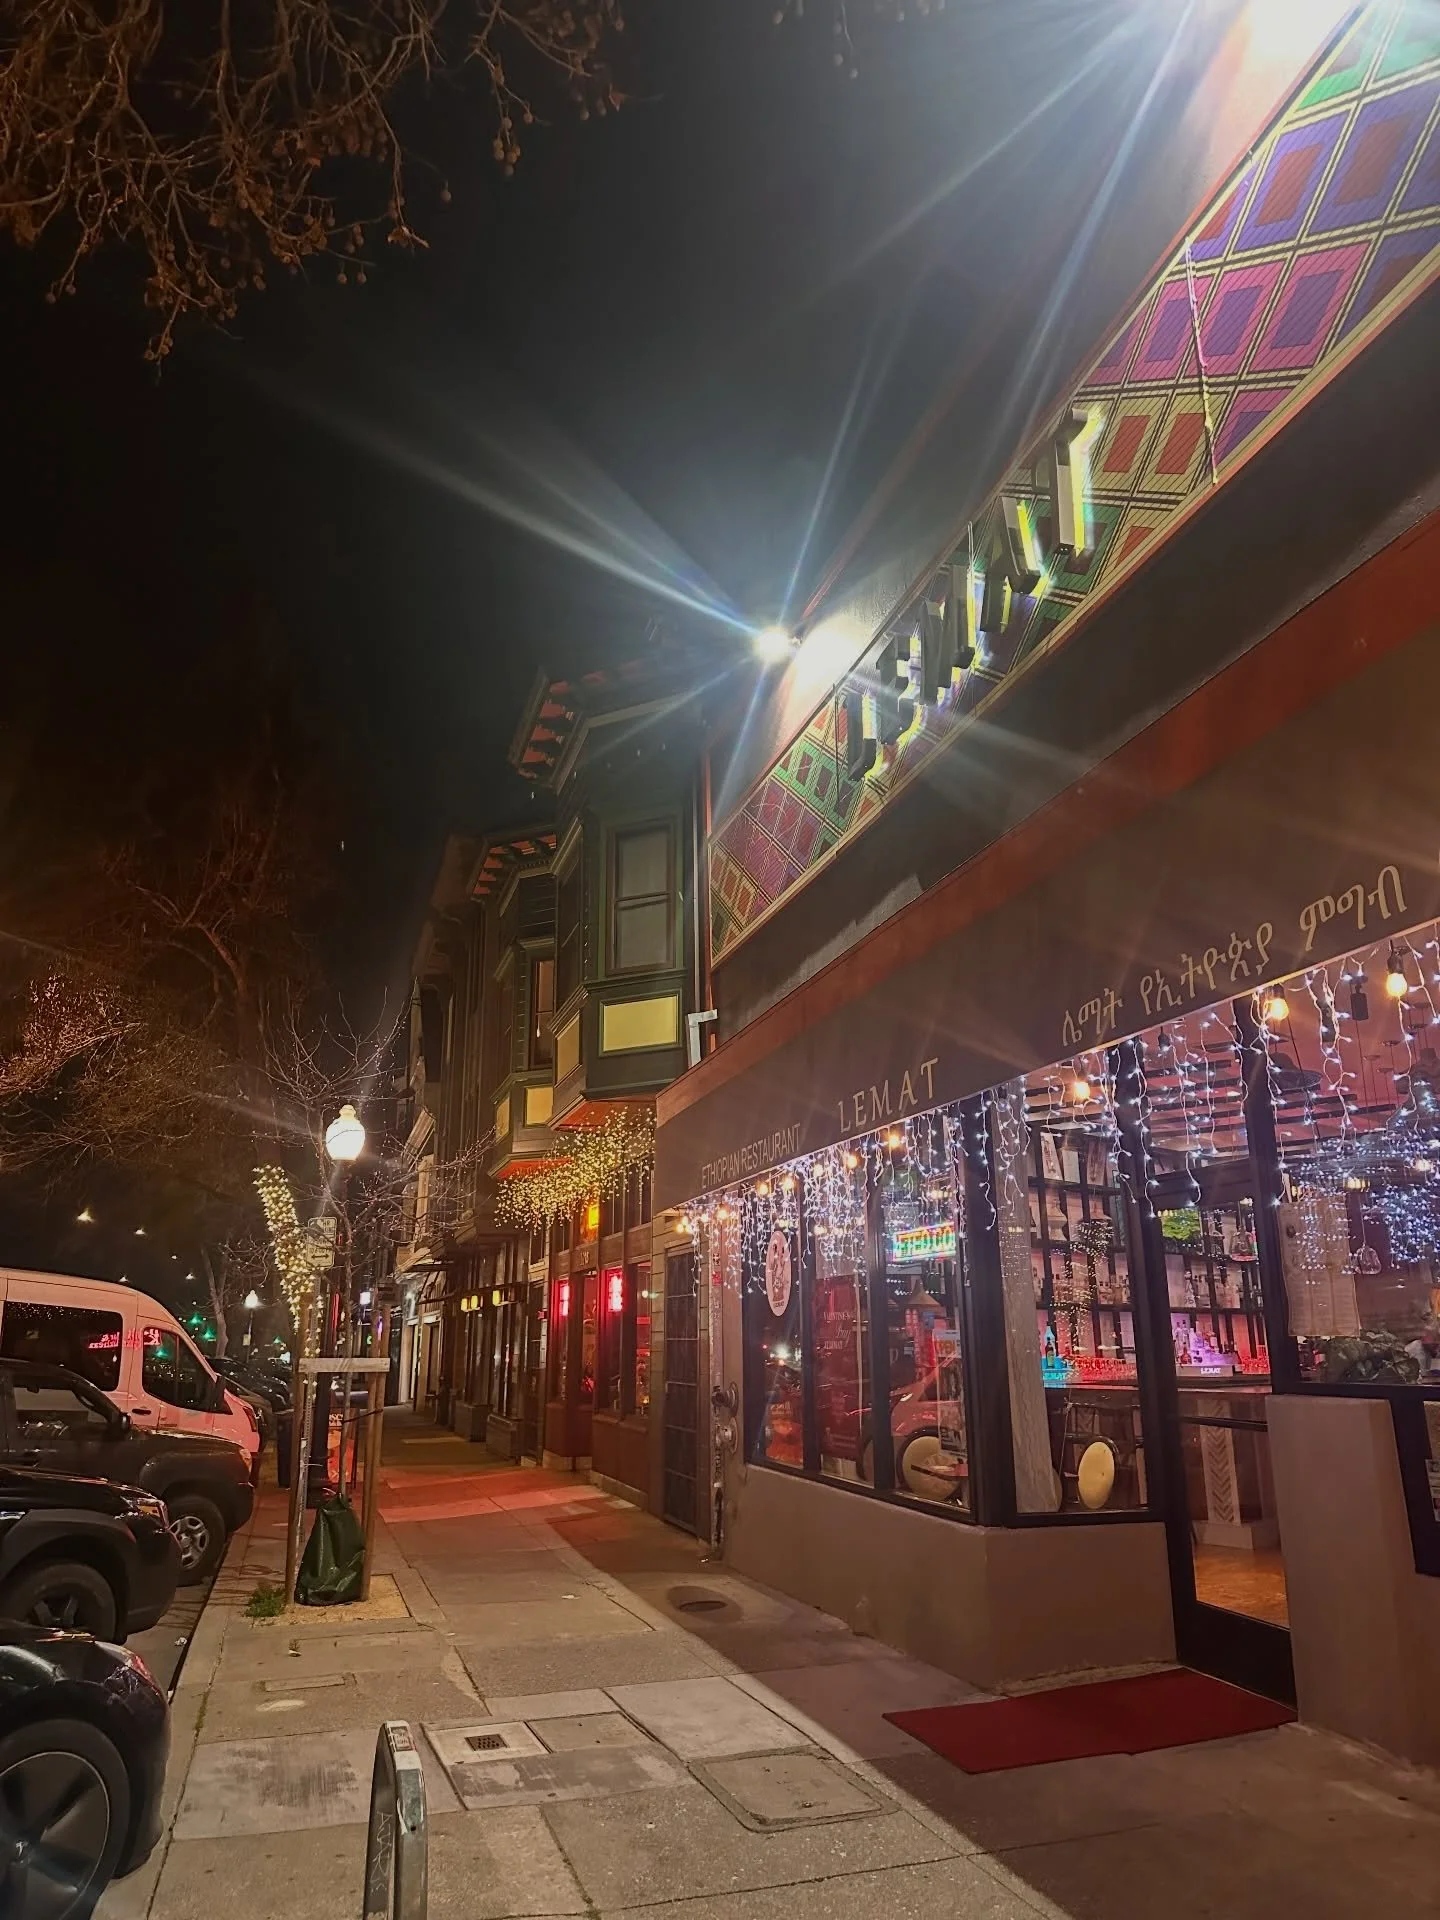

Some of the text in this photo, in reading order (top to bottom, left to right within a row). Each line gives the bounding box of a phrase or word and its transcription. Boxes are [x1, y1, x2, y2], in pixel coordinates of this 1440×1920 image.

[1299, 865, 1408, 952] ምግብ
[838, 1057, 939, 1133] LEMAT
[701, 1123, 801, 1189] ETHIOPIAN RESTAURANT
